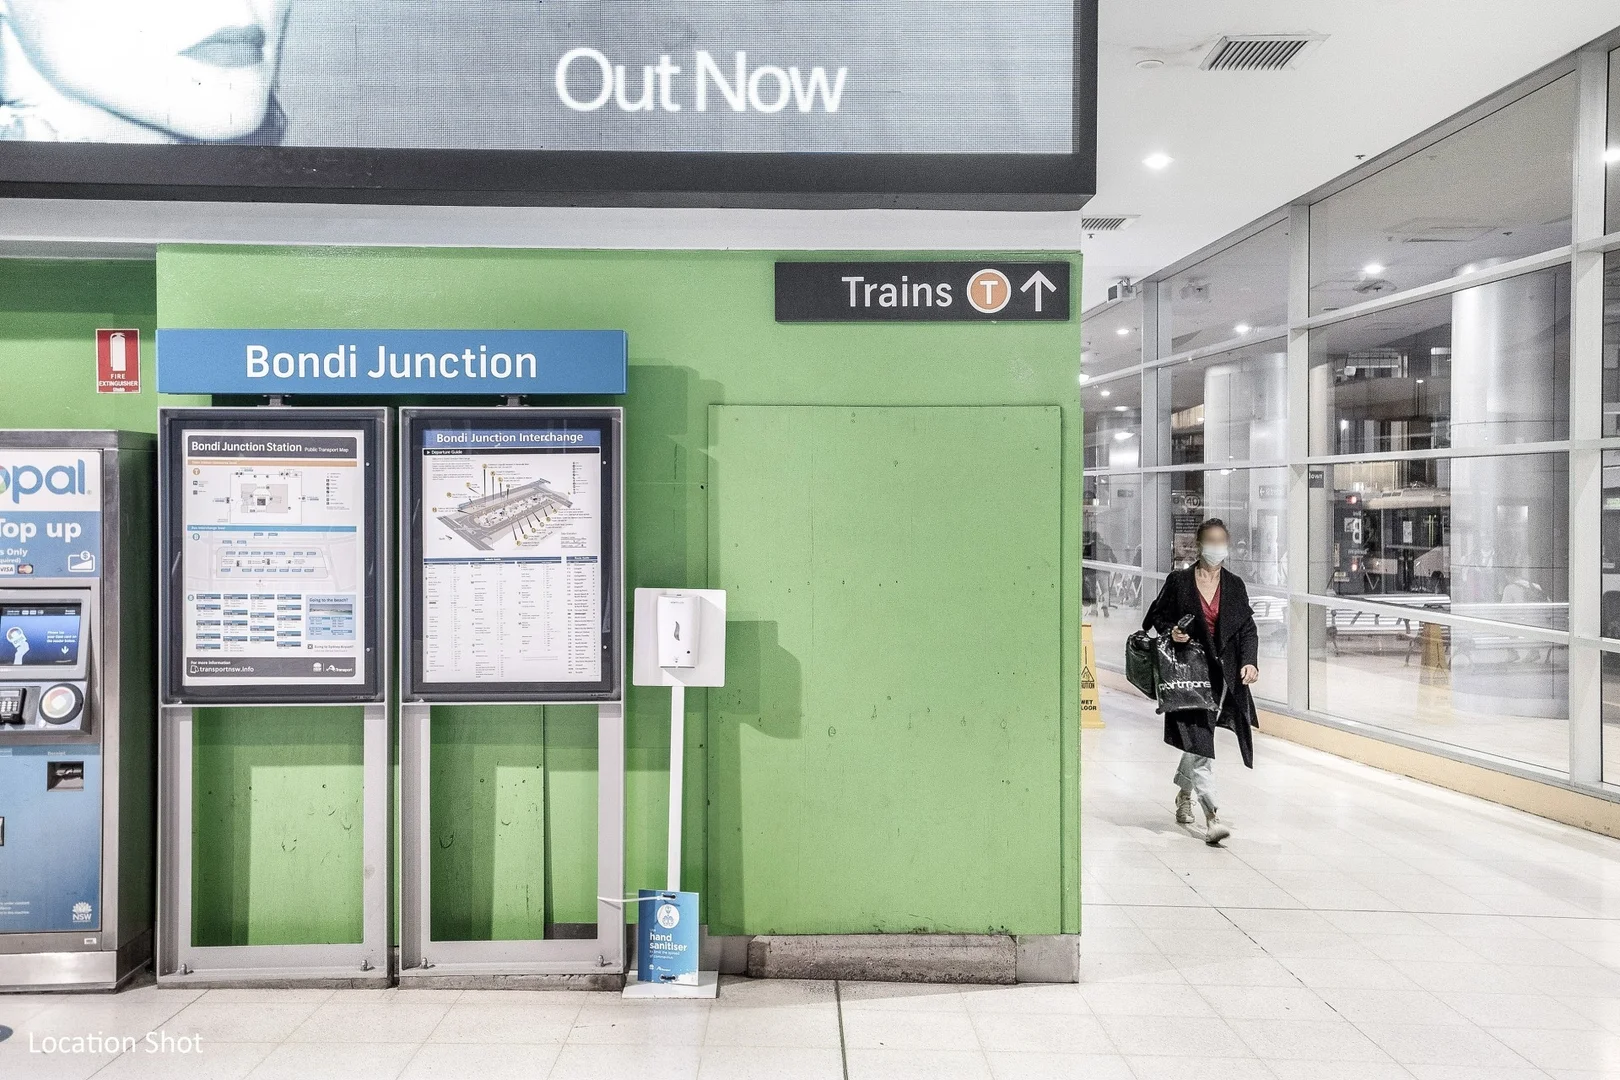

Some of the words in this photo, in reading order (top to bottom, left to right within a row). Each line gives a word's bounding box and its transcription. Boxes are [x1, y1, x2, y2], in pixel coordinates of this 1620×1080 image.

[556, 47, 681, 112] Out
[696, 50, 848, 113] Now
[841, 276, 953, 308] Trains
[246, 344, 357, 378] Bondi
[367, 345, 537, 378] Junction
[436, 432, 468, 442] Bondi
[470, 432, 516, 442] Junction
[519, 432, 584, 442] Interchange
[191, 441, 221, 451] Bondi
[222, 442, 265, 452] Junction
[266, 442, 302, 452] Station
[46, 522, 82, 543] up
[6, 548, 28, 557] Only
[650, 932, 672, 941] hand
[650, 941, 688, 951] sanitiser
